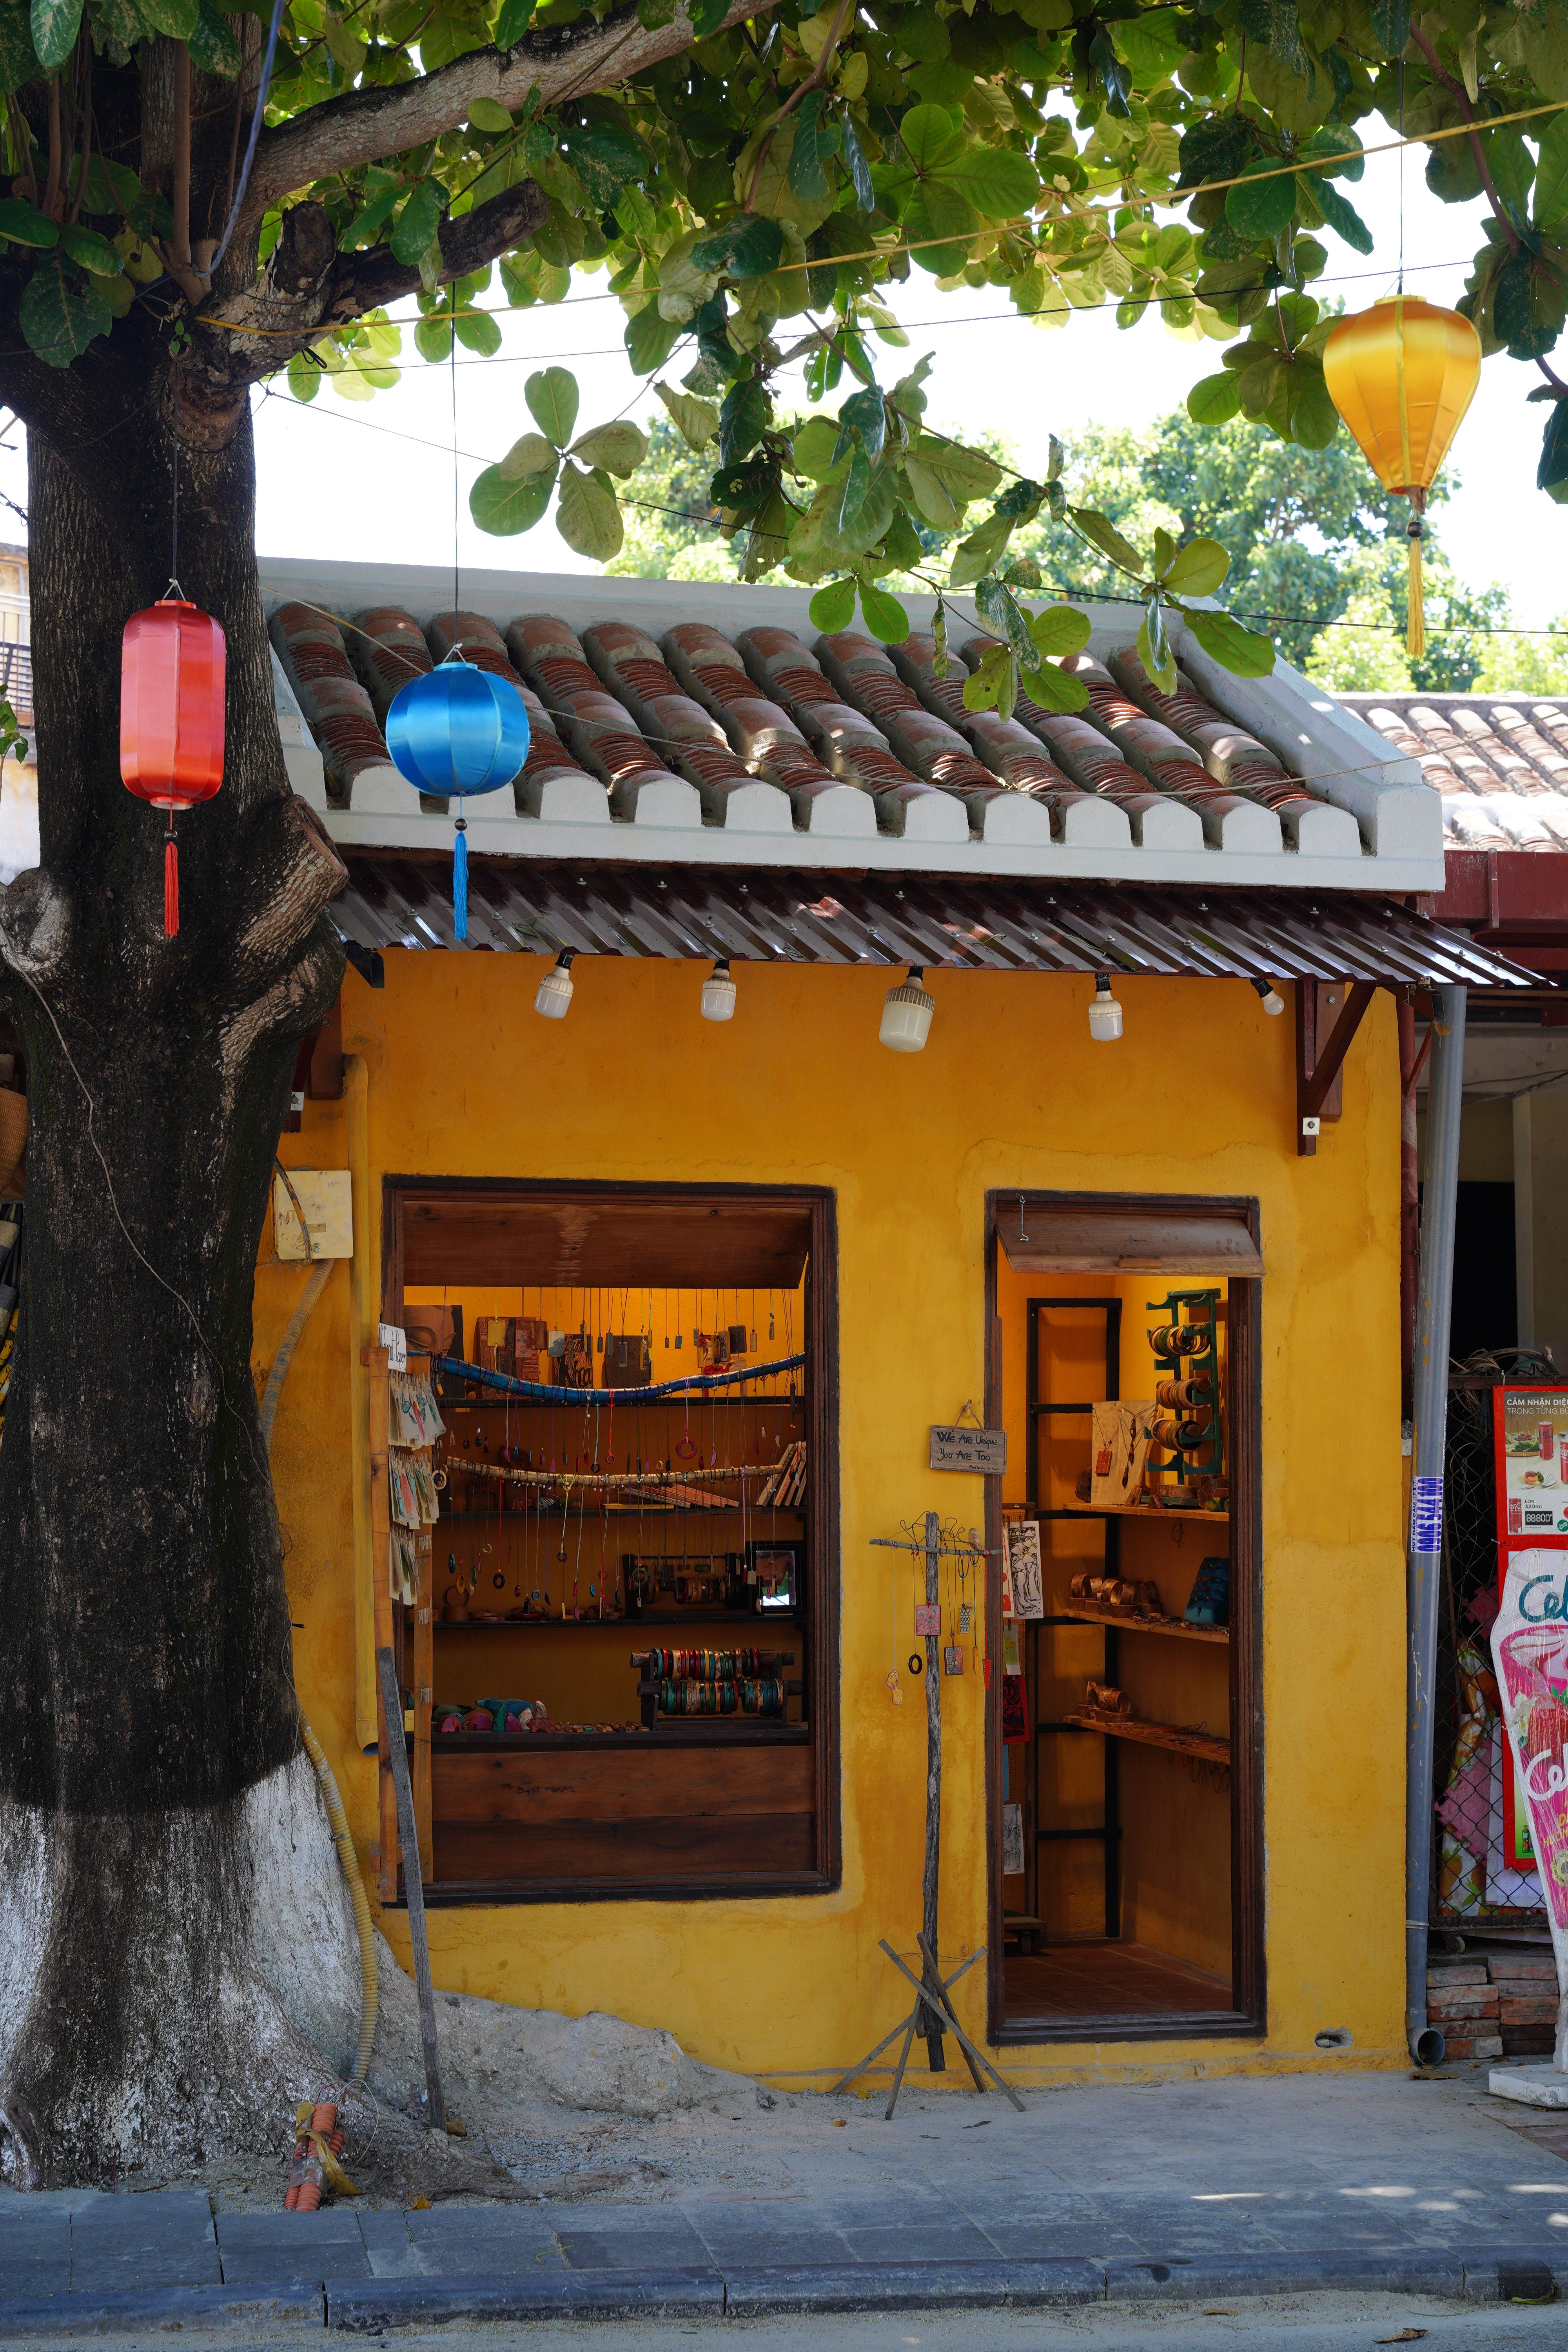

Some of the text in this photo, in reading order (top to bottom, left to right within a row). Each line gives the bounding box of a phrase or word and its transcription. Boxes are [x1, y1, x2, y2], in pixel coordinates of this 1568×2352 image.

[1506, 1397, 1568, 1407] CẢM NHẬN DIỆ
[937, 1448, 953, 1461] You
[975, 1450, 991, 1461] Too
